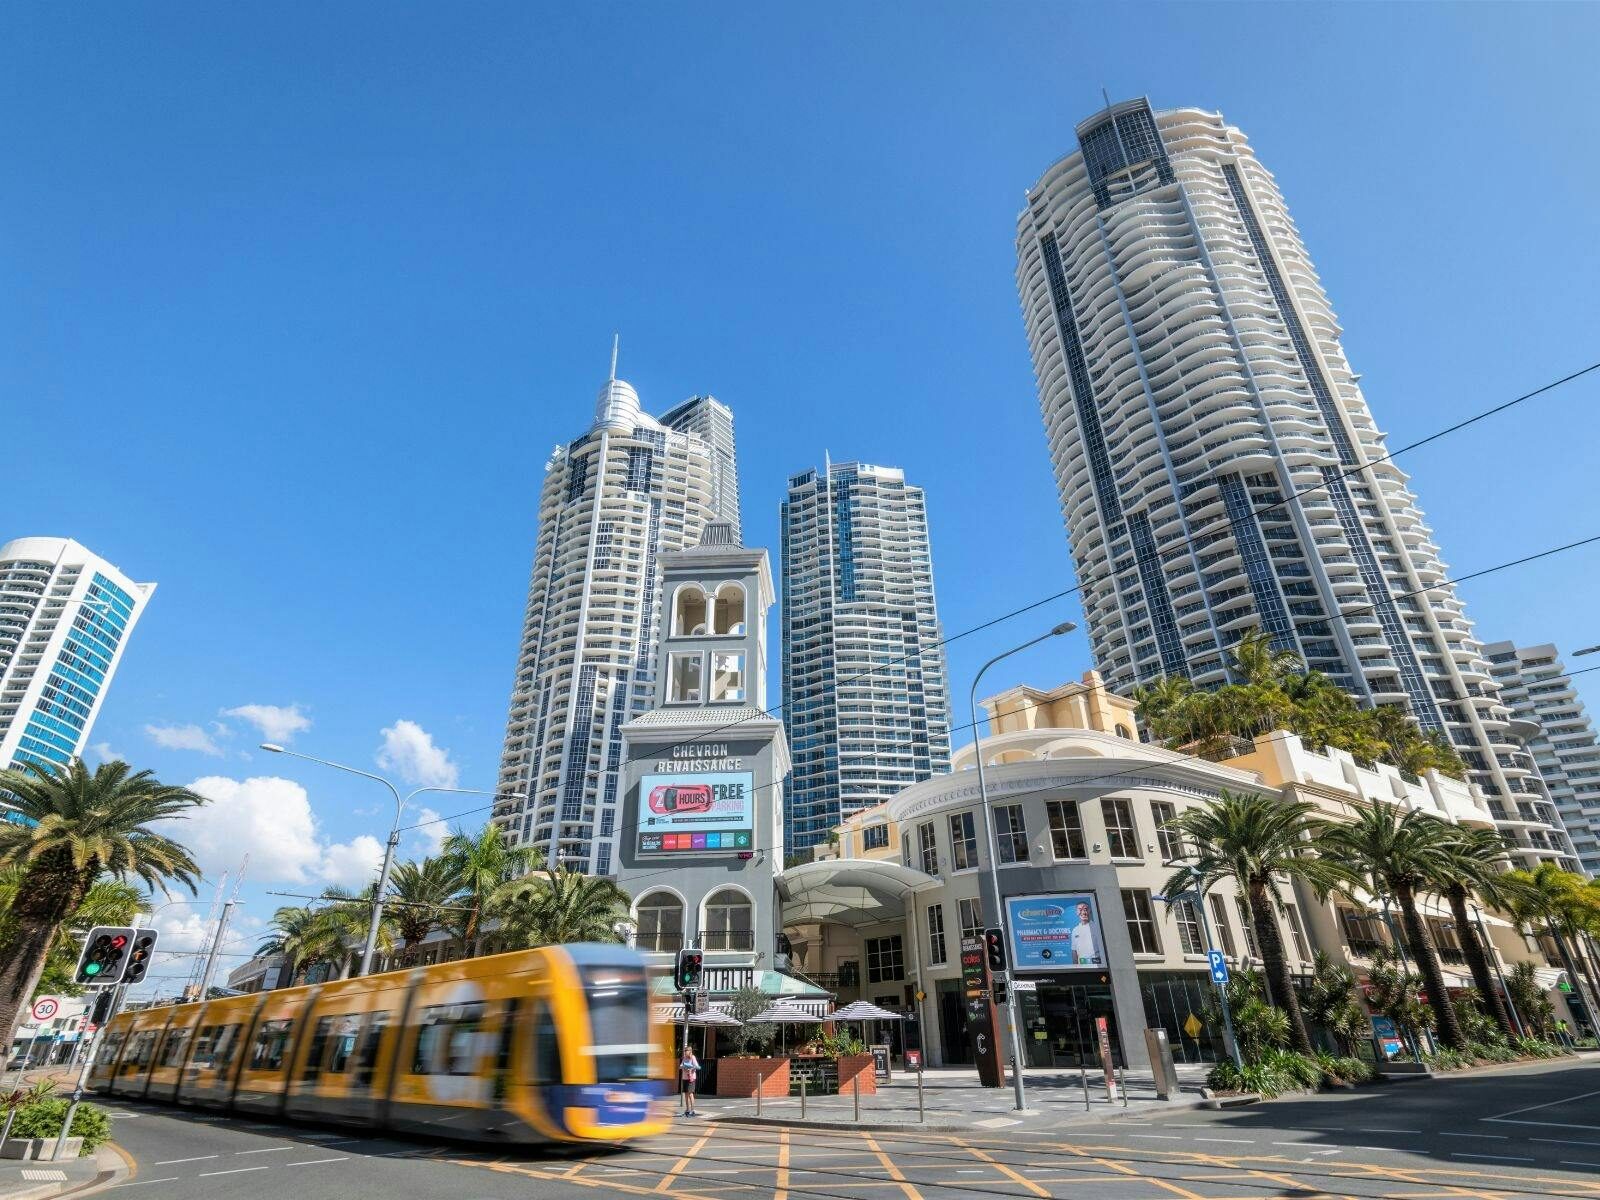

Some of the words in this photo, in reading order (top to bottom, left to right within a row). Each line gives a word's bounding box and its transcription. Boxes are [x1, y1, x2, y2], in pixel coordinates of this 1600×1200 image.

[673, 744, 728, 758] CHEVRON
[658, 758, 742, 772] RENAISSANCE
[679, 793, 706, 804] HOURS
[711, 784, 744, 800] FREE
[711, 800, 744, 812] PARKING
[1211, 953, 1221, 968] P
[37, 1004, 54, 1014] 30
